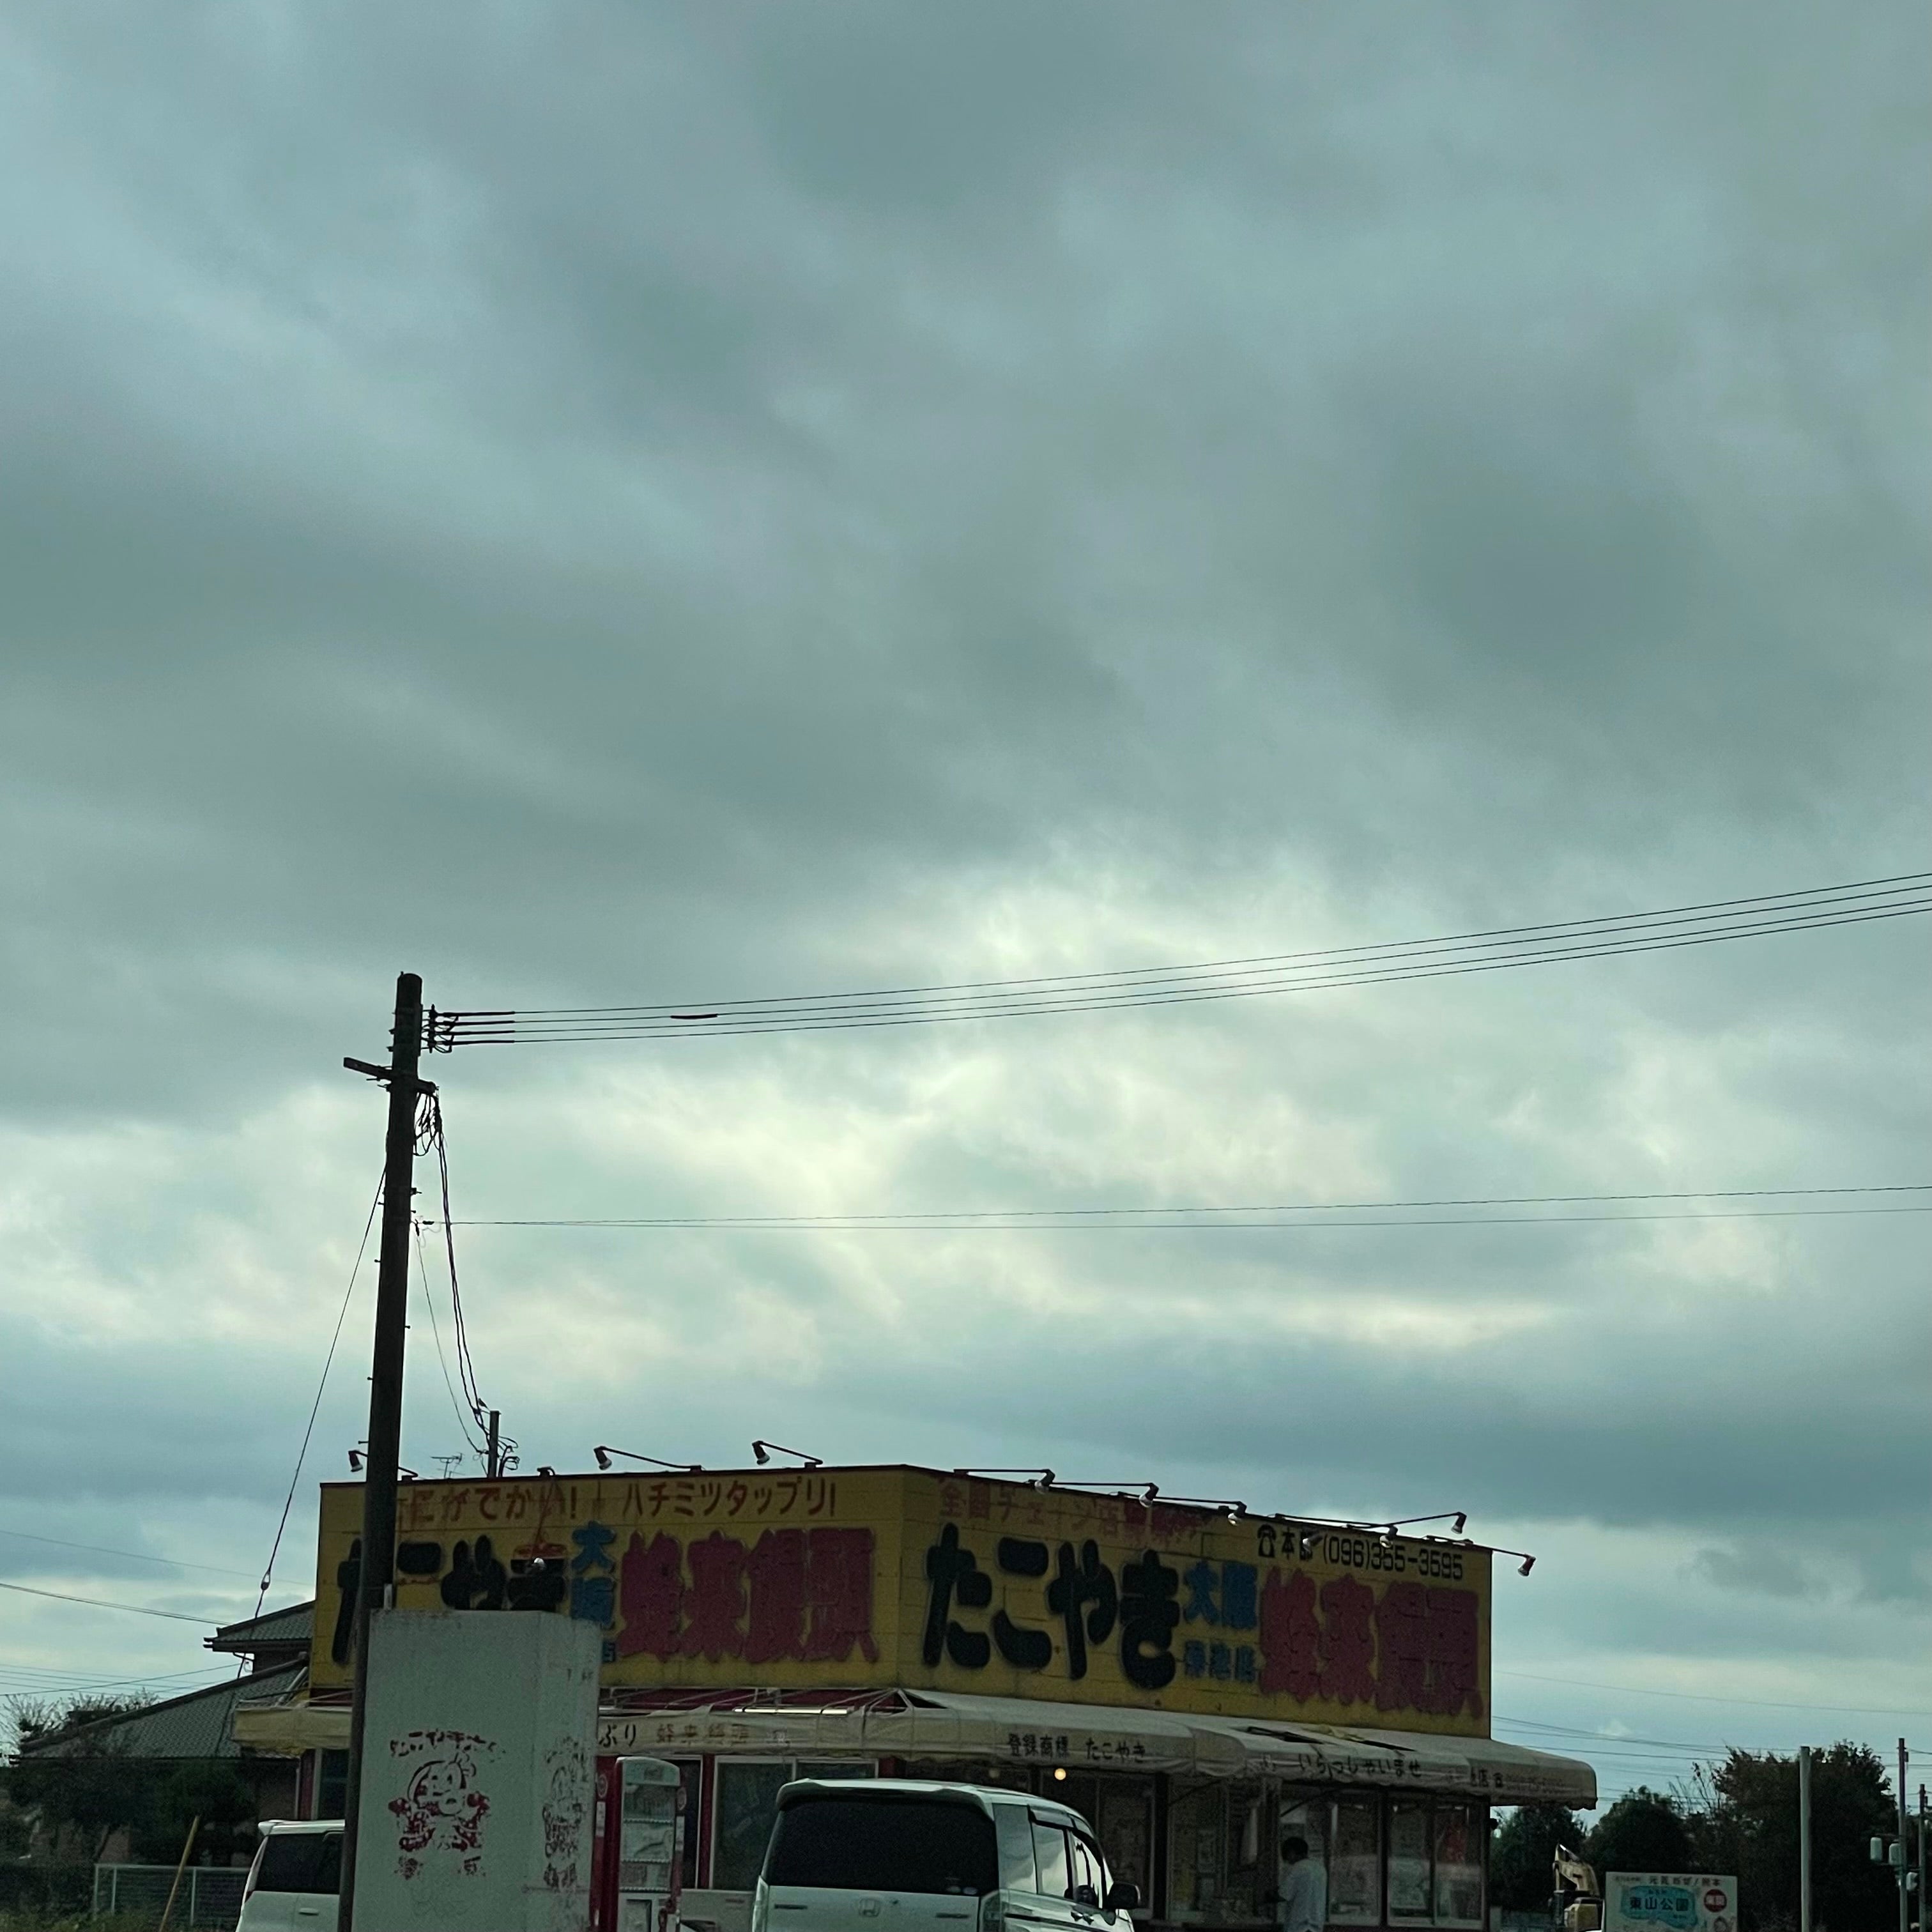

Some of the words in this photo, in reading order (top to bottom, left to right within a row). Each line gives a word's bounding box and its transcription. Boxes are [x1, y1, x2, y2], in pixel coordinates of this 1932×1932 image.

[922, 1522, 1180, 1689] たこやき
[1085, 1736, 1146, 1763] たこやき
[1630, 1896, 1689, 1912] 東山公園
